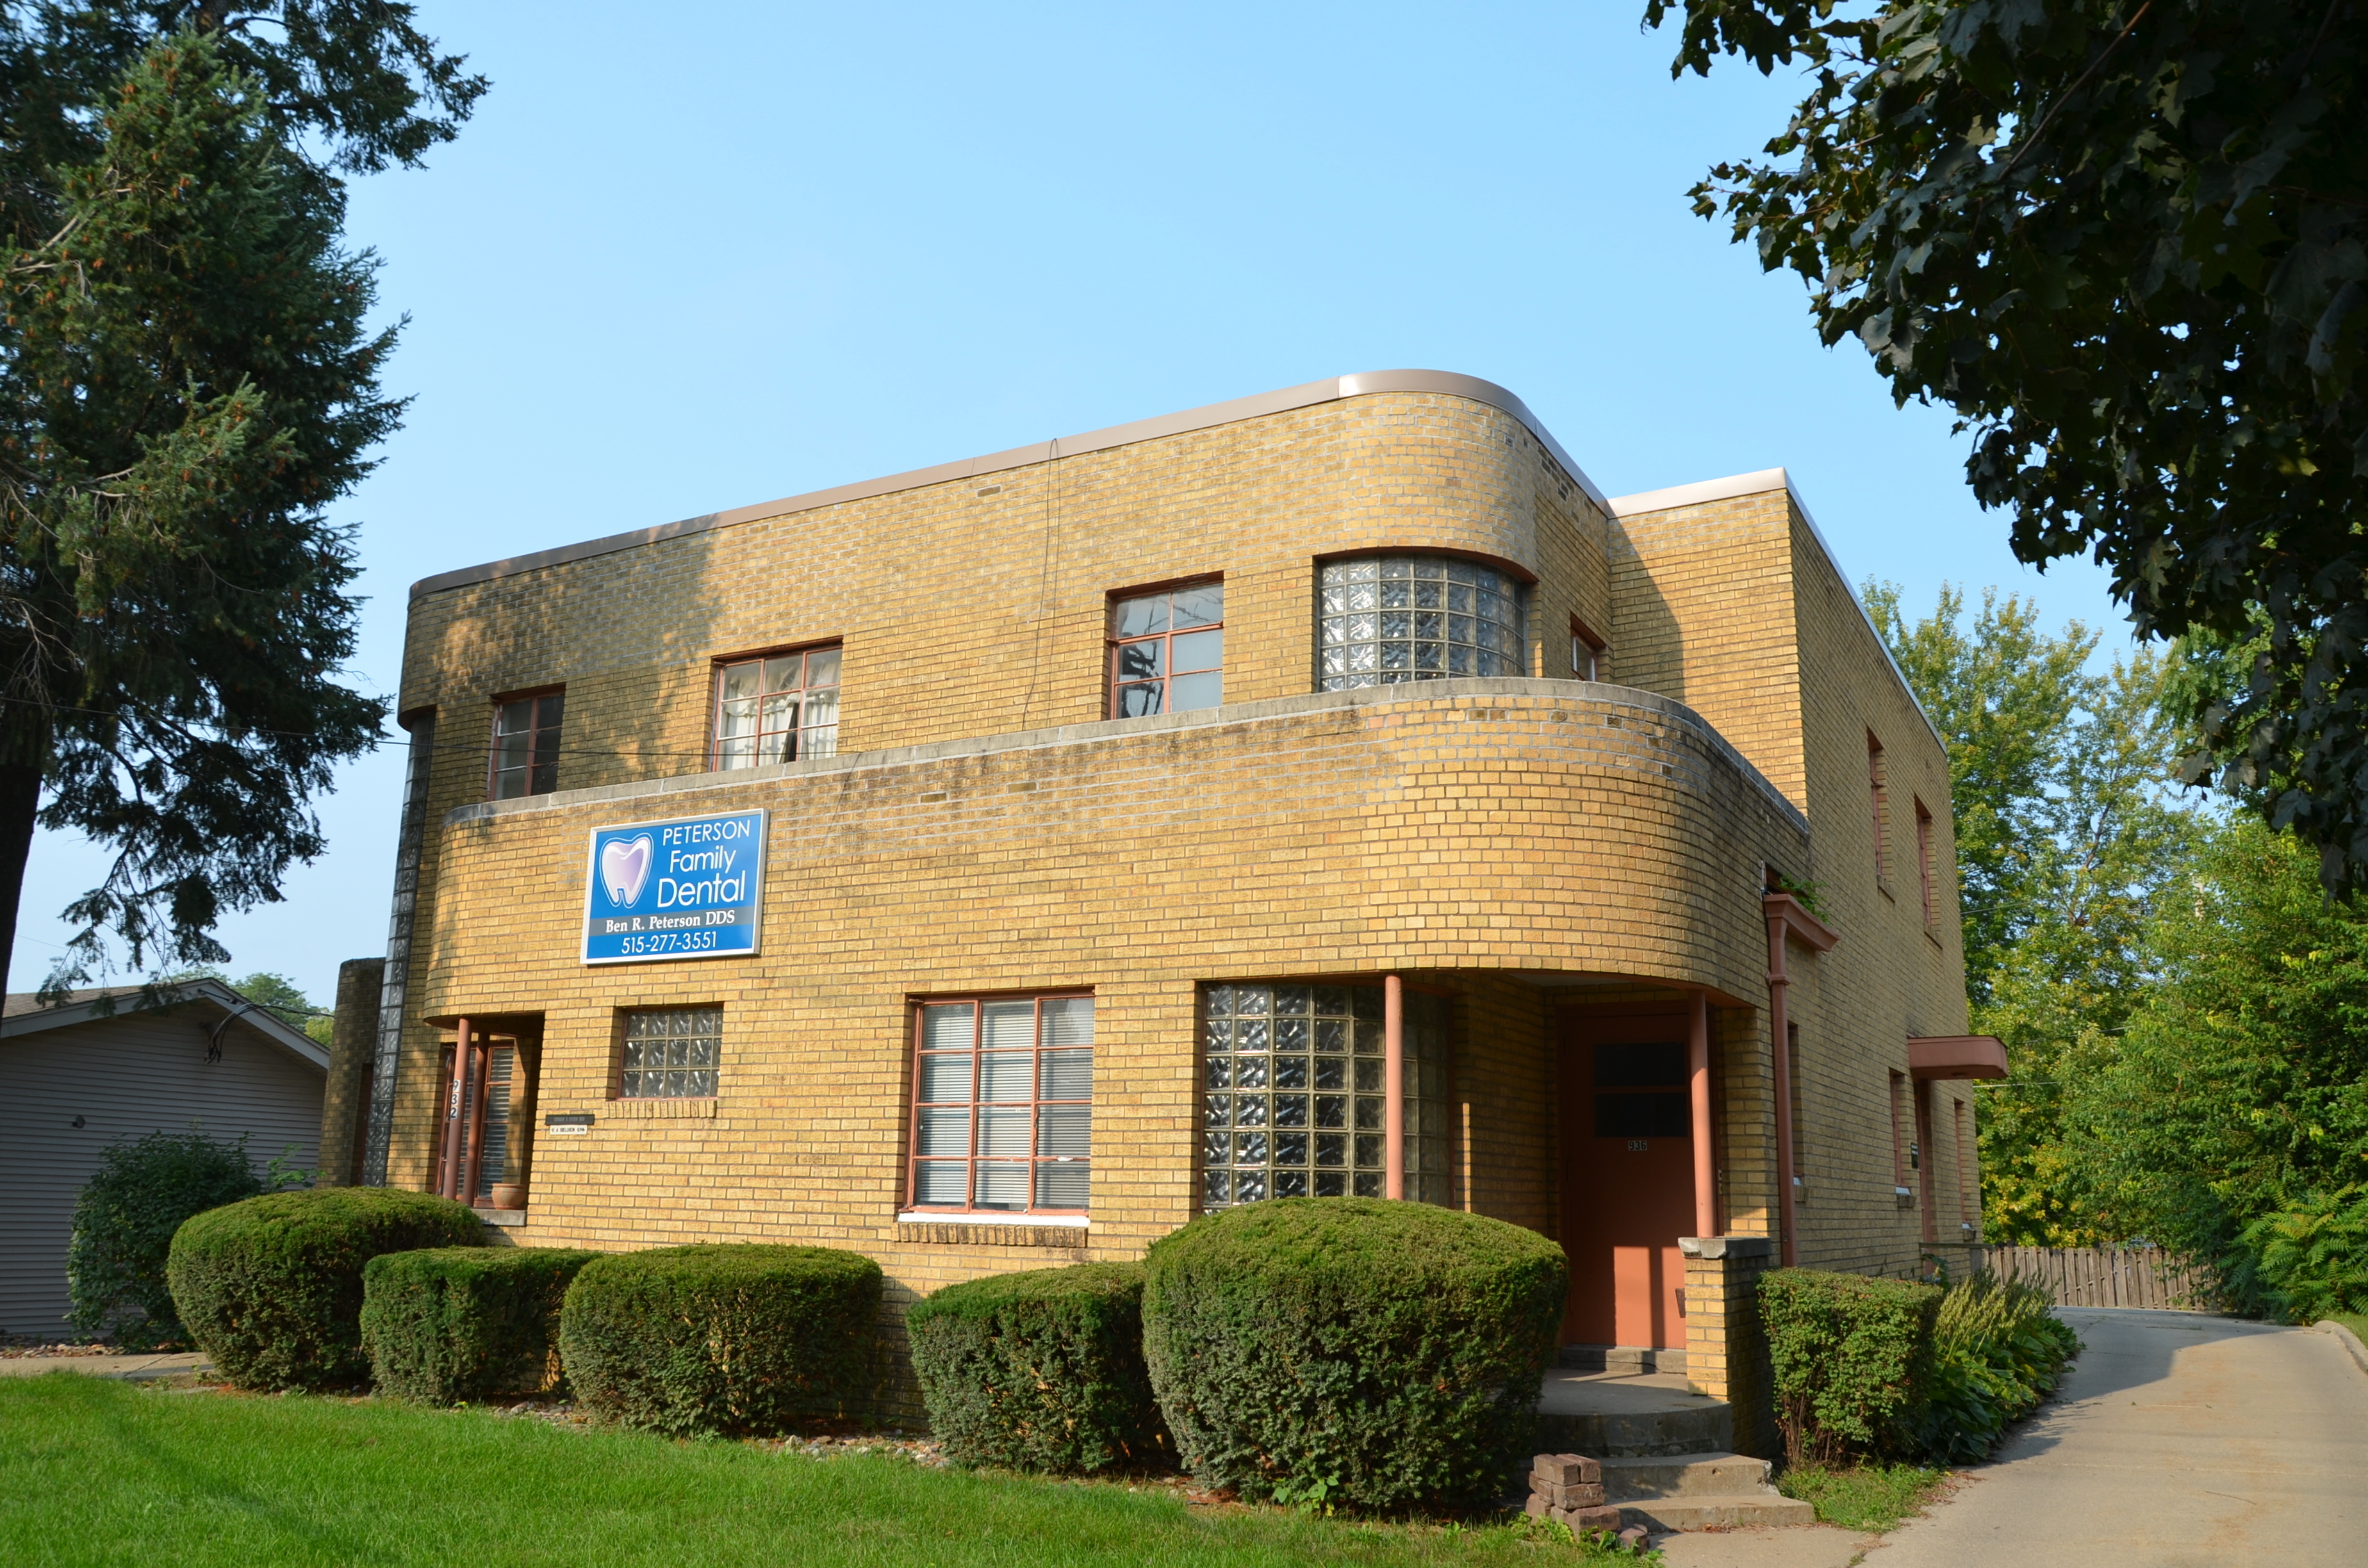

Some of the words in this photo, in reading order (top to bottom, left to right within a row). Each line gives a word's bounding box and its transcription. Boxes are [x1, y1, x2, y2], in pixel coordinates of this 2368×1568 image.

[662, 819, 750, 846] PETERSON
[670, 845, 737, 874] Family
[657, 870, 746, 908] Dental
[605, 919, 628, 933] Ben
[632, 917, 645, 931] R.
[649, 916, 701, 929] Peterson
[705, 910, 735, 925] DDS
[621, 931, 716, 954] 515-277-3551
[1629, 1141, 1647, 1150] 936
